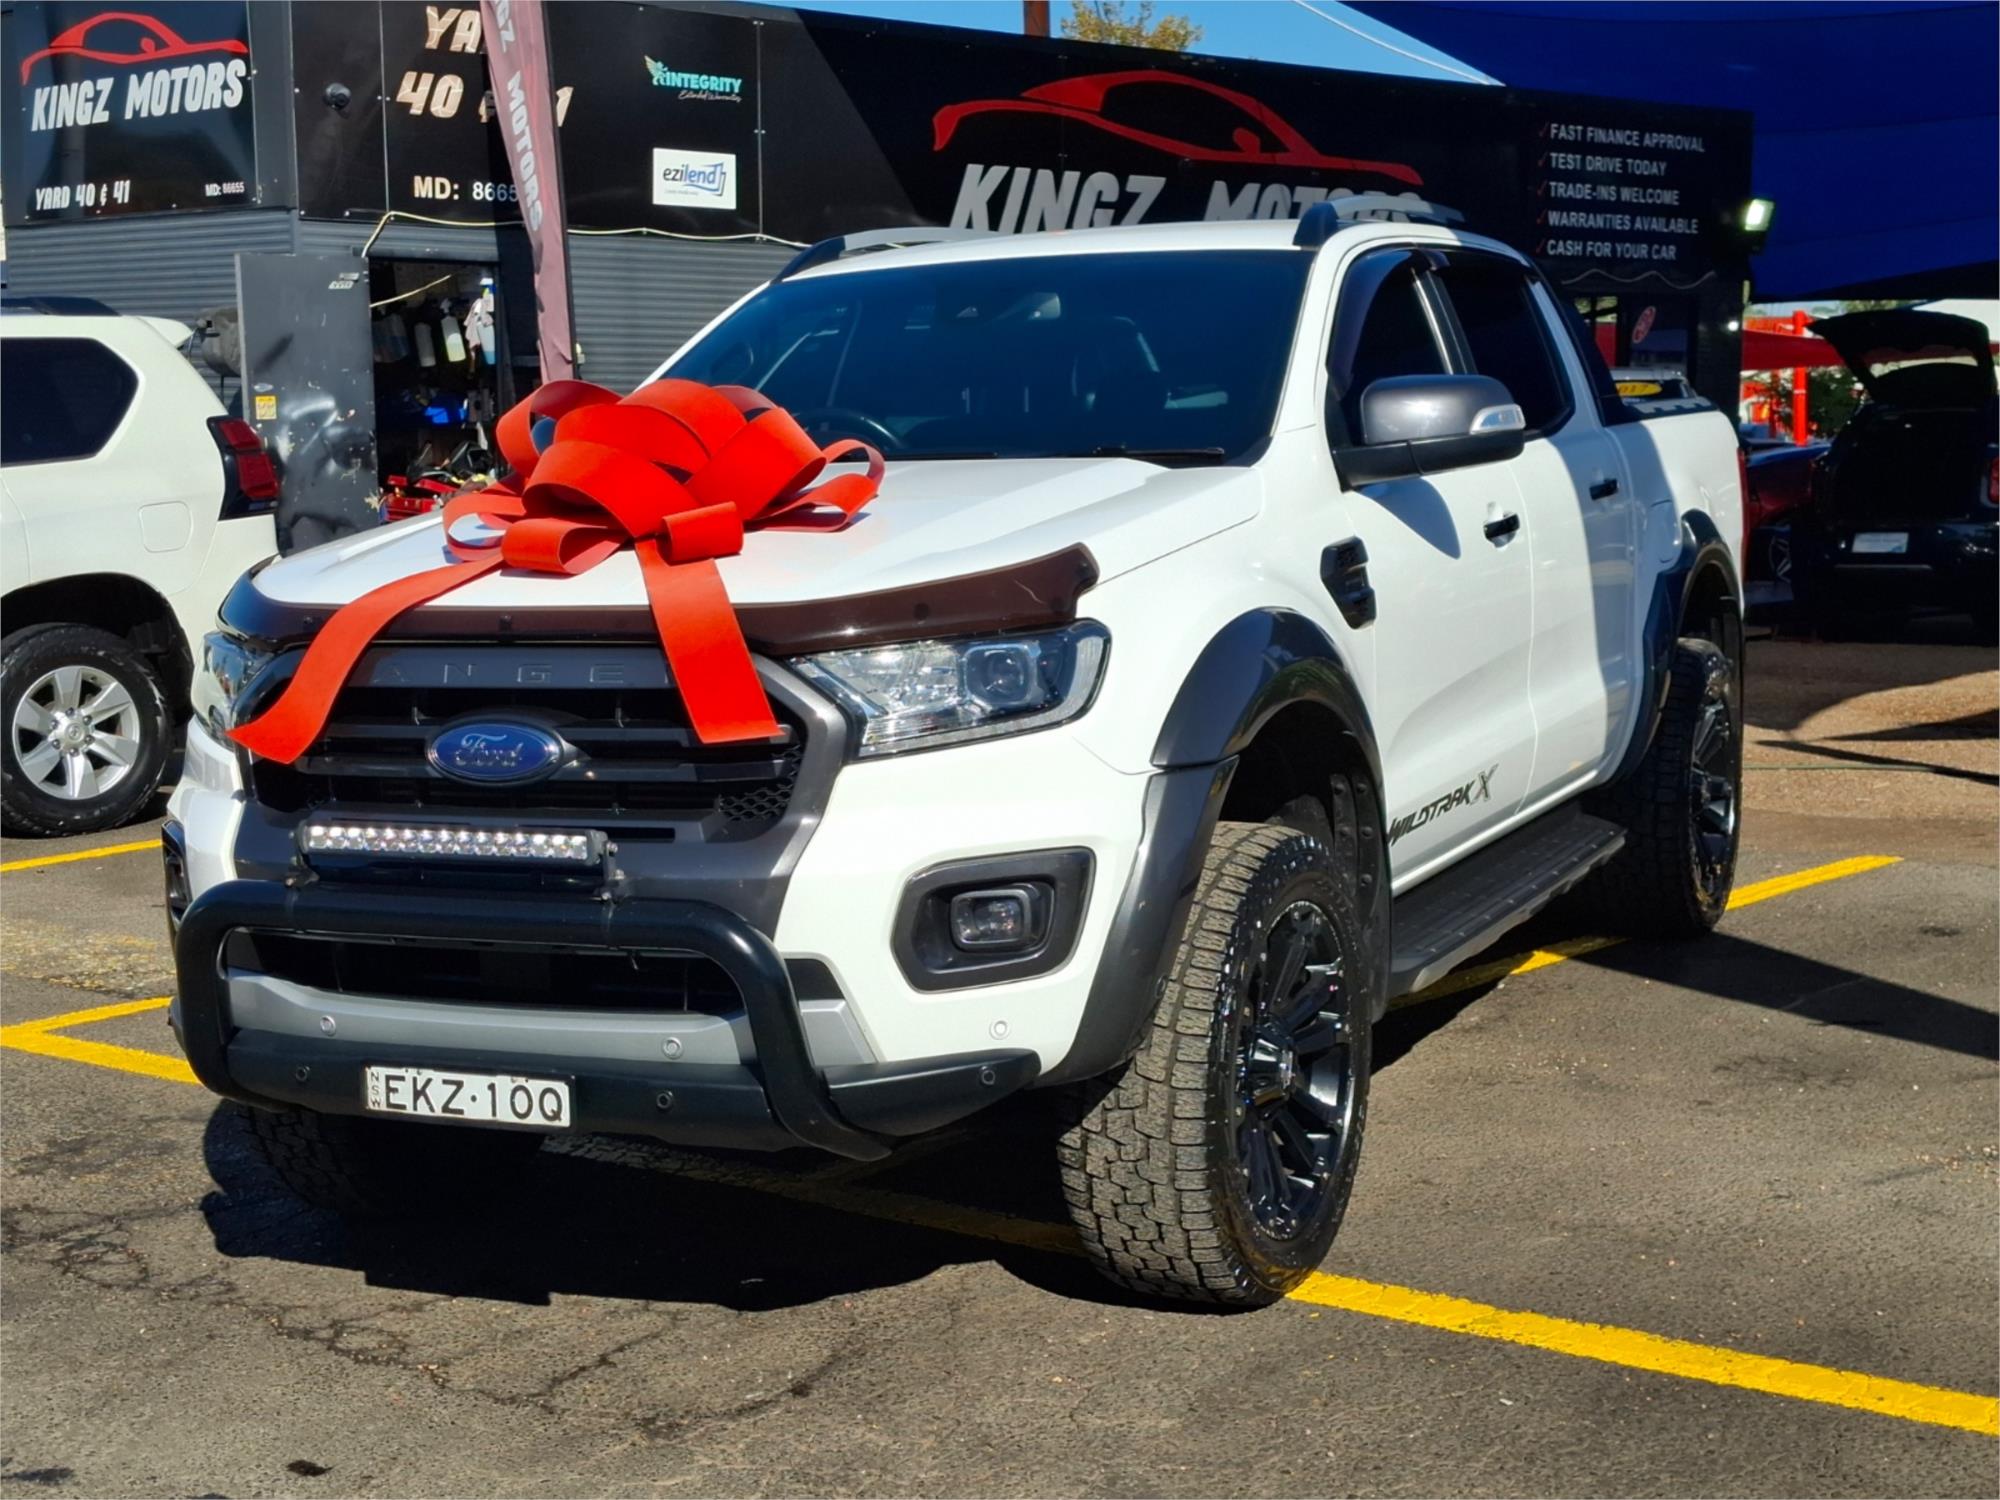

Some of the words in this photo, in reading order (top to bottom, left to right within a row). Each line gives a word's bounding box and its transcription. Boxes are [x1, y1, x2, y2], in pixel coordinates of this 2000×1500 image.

[425, 5, 487, 54] YA
[31, 77, 115, 132] KINGZ
[124, 58, 247, 120] MOTORS
[395, 70, 465, 119] 40
[666, 71, 742, 93] INTEGRITY
[507, 70, 544, 232] MOTORS
[1550, 123, 1583, 141] FAST
[1586, 126, 1640, 147] FINANCE
[1643, 132, 1705, 152] APPROVAL
[663, 163, 716, 184] ezilend
[1549, 152, 1582, 170] TEST
[1585, 155, 1623, 174] DRIVE
[1626, 158, 1667, 177] TODAY
[35, 186, 71, 211] YARD
[75, 183, 96, 207] 40
[99, 183, 109, 206] &
[113, 179, 131, 204] 41
[205, 183, 222, 197] MD:
[413, 175, 459, 200] MD:
[472, 181, 519, 203] 8665
[949, 163, 1167, 235] KINGZ
[1549, 181, 1617, 202] TRADE-INS
[1620, 187, 1680, 206] WELCOME
[1547, 210, 1631, 231] WARRANTIES
[1633, 216, 1699, 235] AVAILABLE
[1546, 239, 1582, 257] CASH
[1586, 241, 1612, 258] FOR
[1615, 242, 1649, 260] YOUR
[1651, 244, 1677, 261] CAR
[373, 663, 669, 684] ANGE
[454, 733, 525, 768] Ford
[1387, 779, 1475, 847] WILDTRAK
